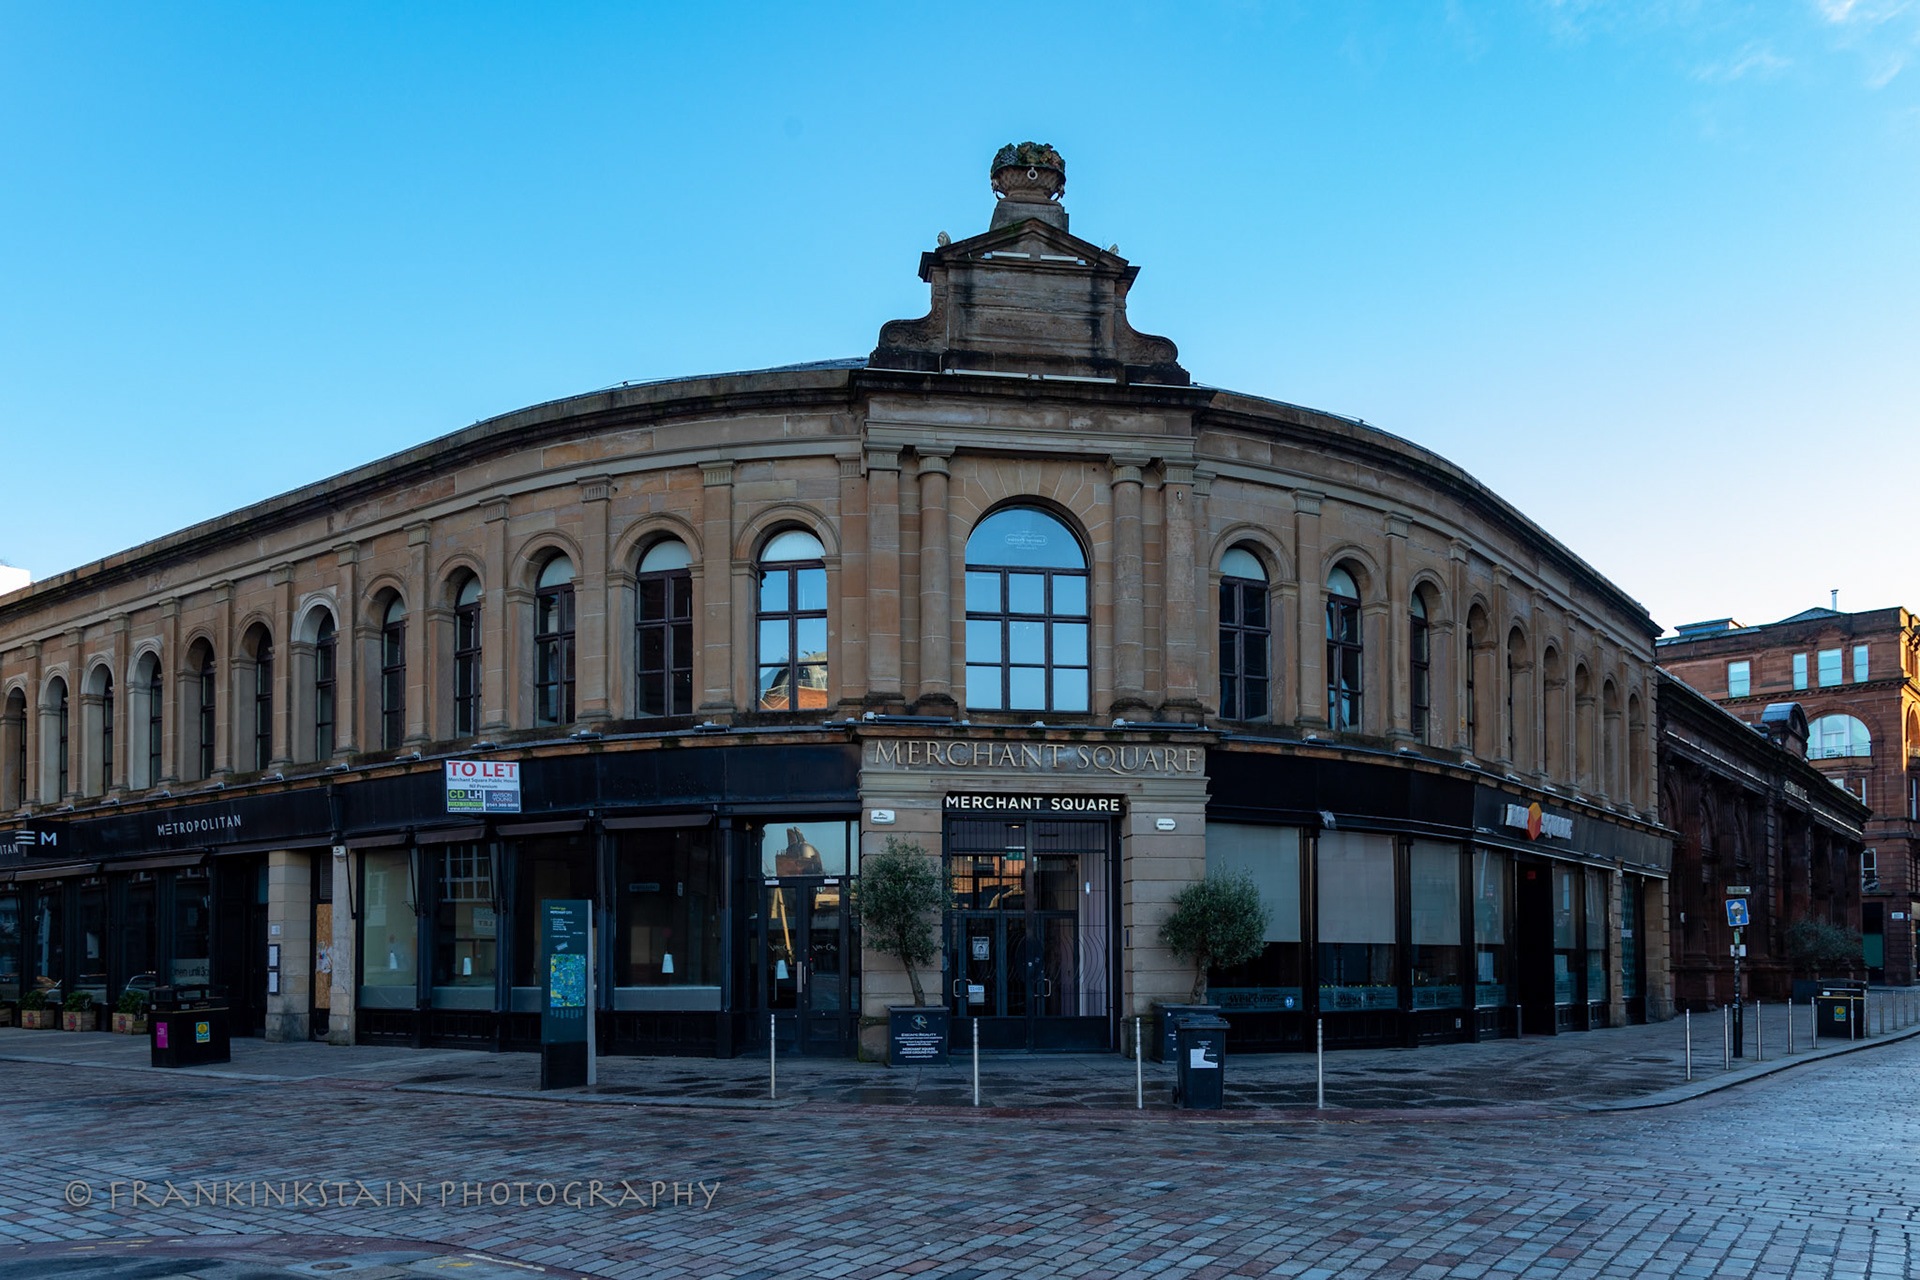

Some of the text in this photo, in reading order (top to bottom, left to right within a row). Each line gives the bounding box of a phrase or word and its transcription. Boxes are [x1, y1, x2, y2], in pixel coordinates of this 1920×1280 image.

[874, 739, 1198, 775] MERCHANT SQUARE
[447, 762, 517, 778] TO LET
[449, 789, 482, 799] CD LH
[945, 795, 1120, 811] MERCHANT SQUARE
[157, 814, 242, 836] METROPOLITAN
